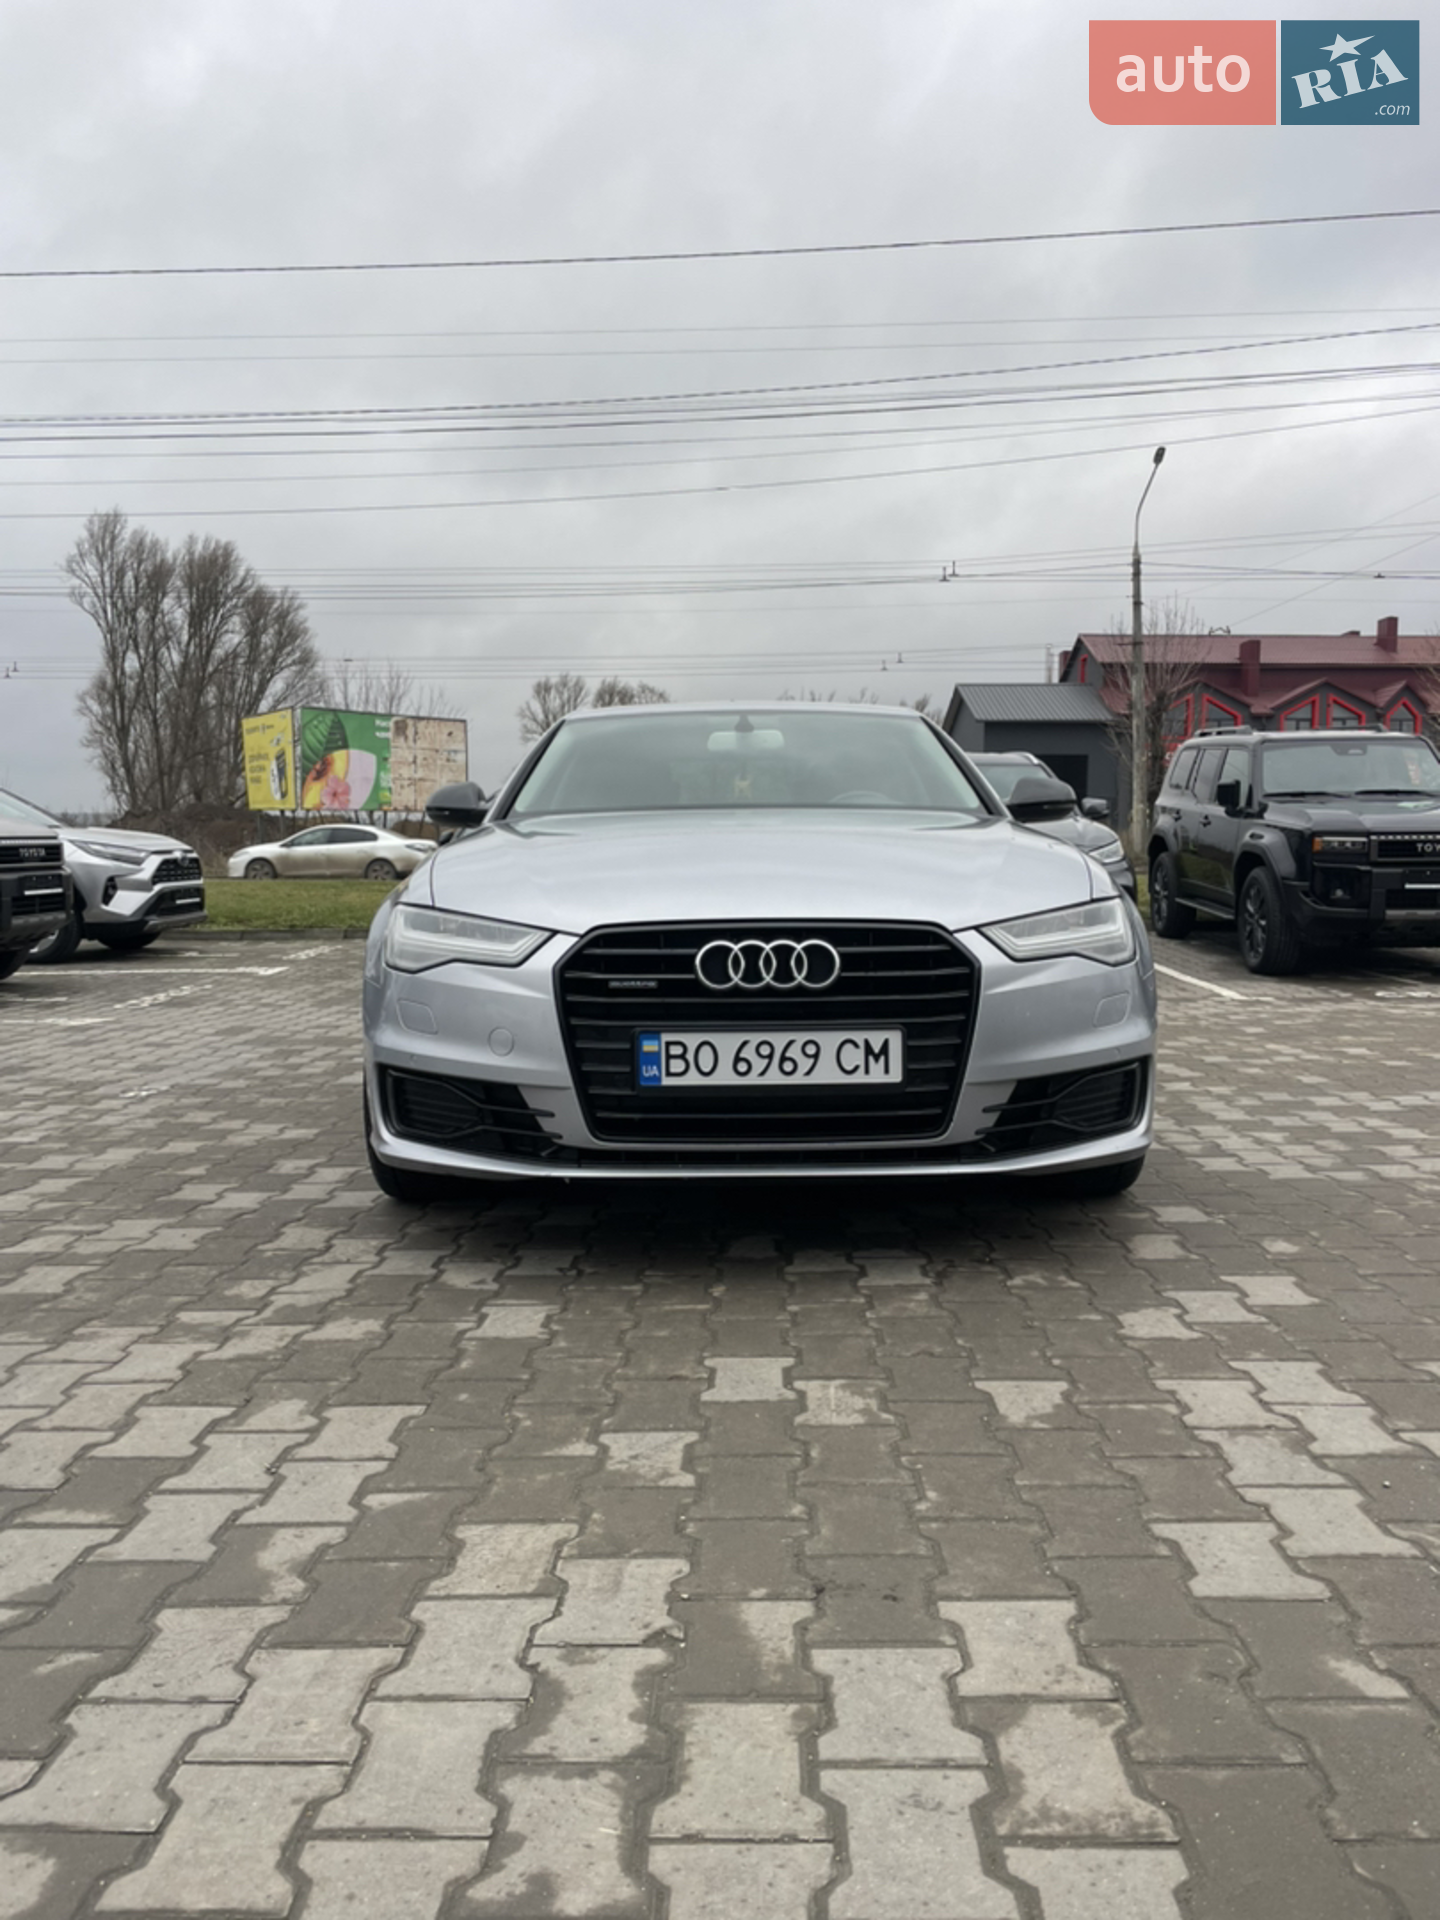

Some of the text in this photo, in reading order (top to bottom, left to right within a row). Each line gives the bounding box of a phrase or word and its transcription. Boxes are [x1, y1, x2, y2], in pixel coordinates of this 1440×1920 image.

[664, 1037, 890, 1078] BO 6969 CM
[642, 1065, 659, 1077] UA
